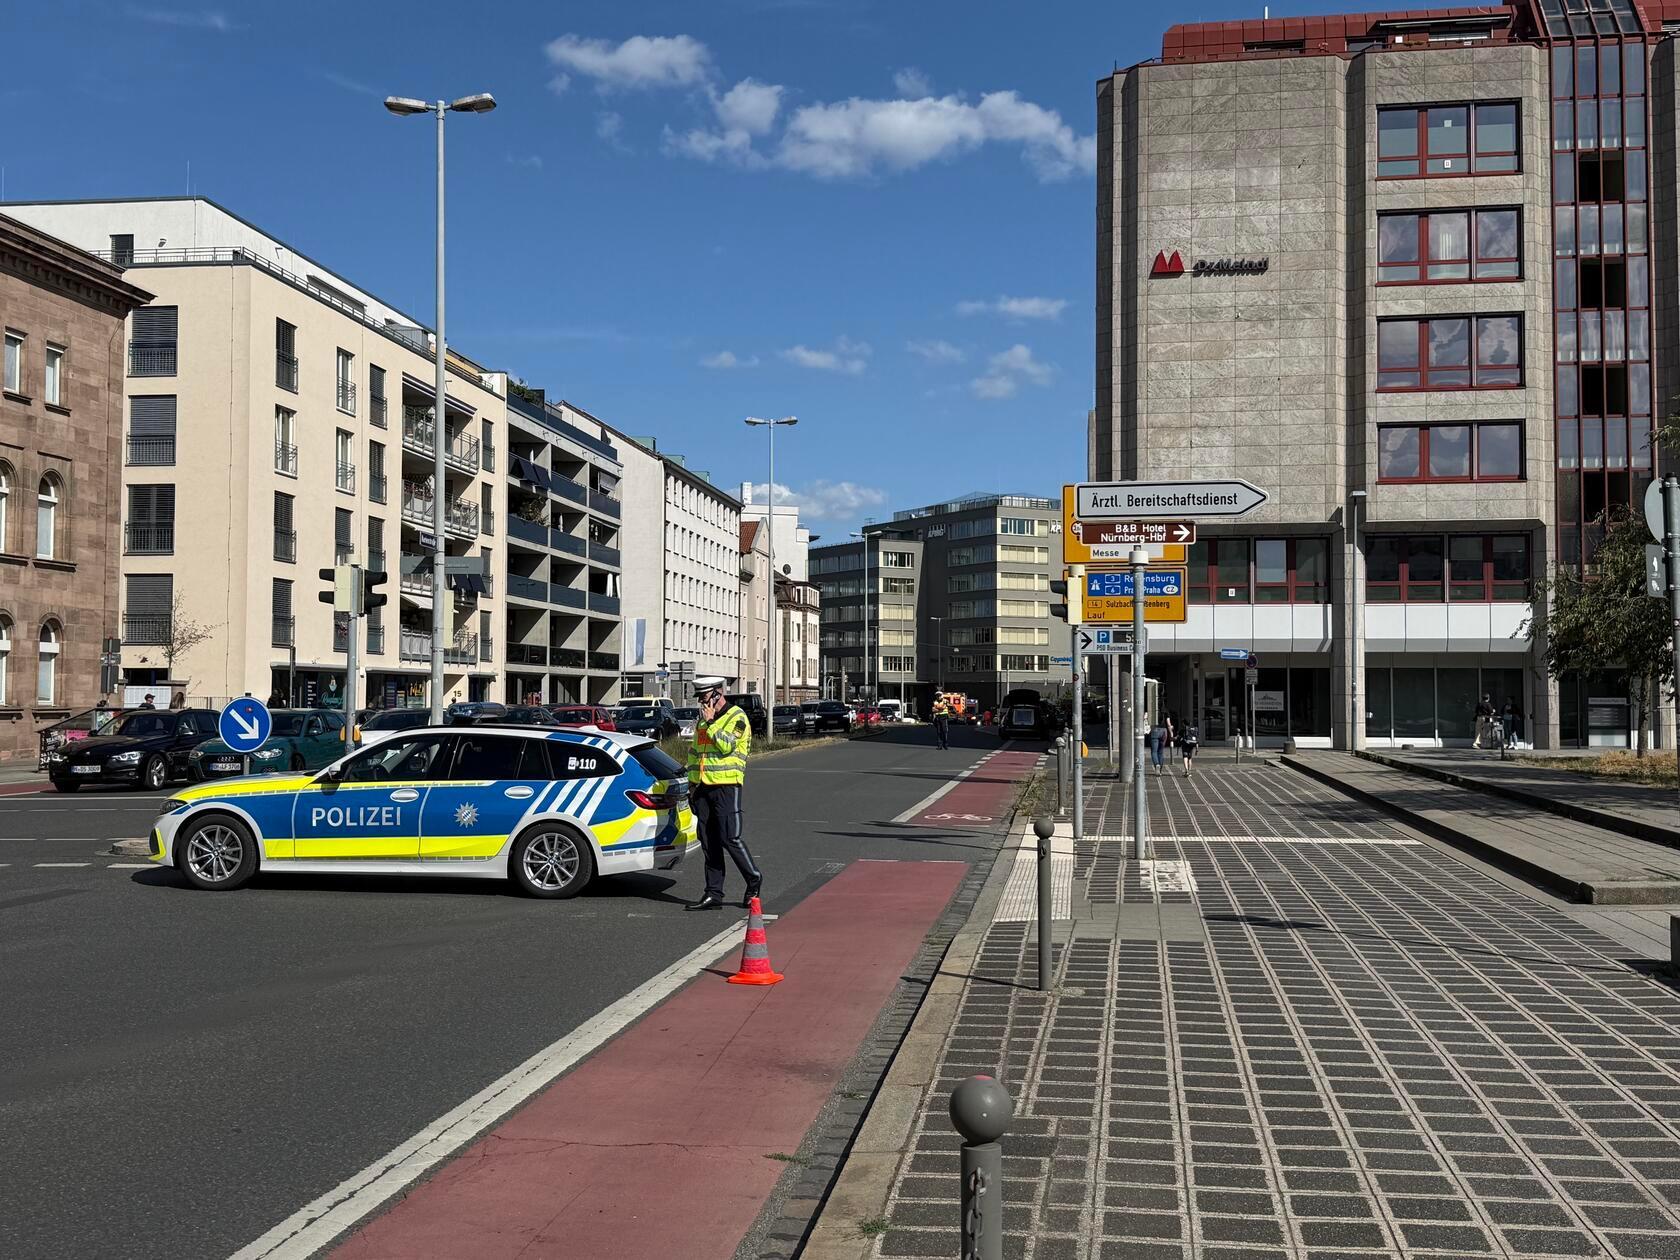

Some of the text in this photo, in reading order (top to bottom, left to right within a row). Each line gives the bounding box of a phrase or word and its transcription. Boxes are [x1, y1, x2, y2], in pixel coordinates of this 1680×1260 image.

[1092, 493, 1238, 508] Ärztl. Bereitschaftsdienst
[1115, 524, 1167, 533] B&B Hotel
[1100, 533, 1167, 543] Nürnberg-Hbf
[1124, 575, 1175, 584] Rensburg
[1099, 632, 1108, 642] P
[579, 758, 596, 770] 110
[312, 807, 401, 827] POLIZEI
